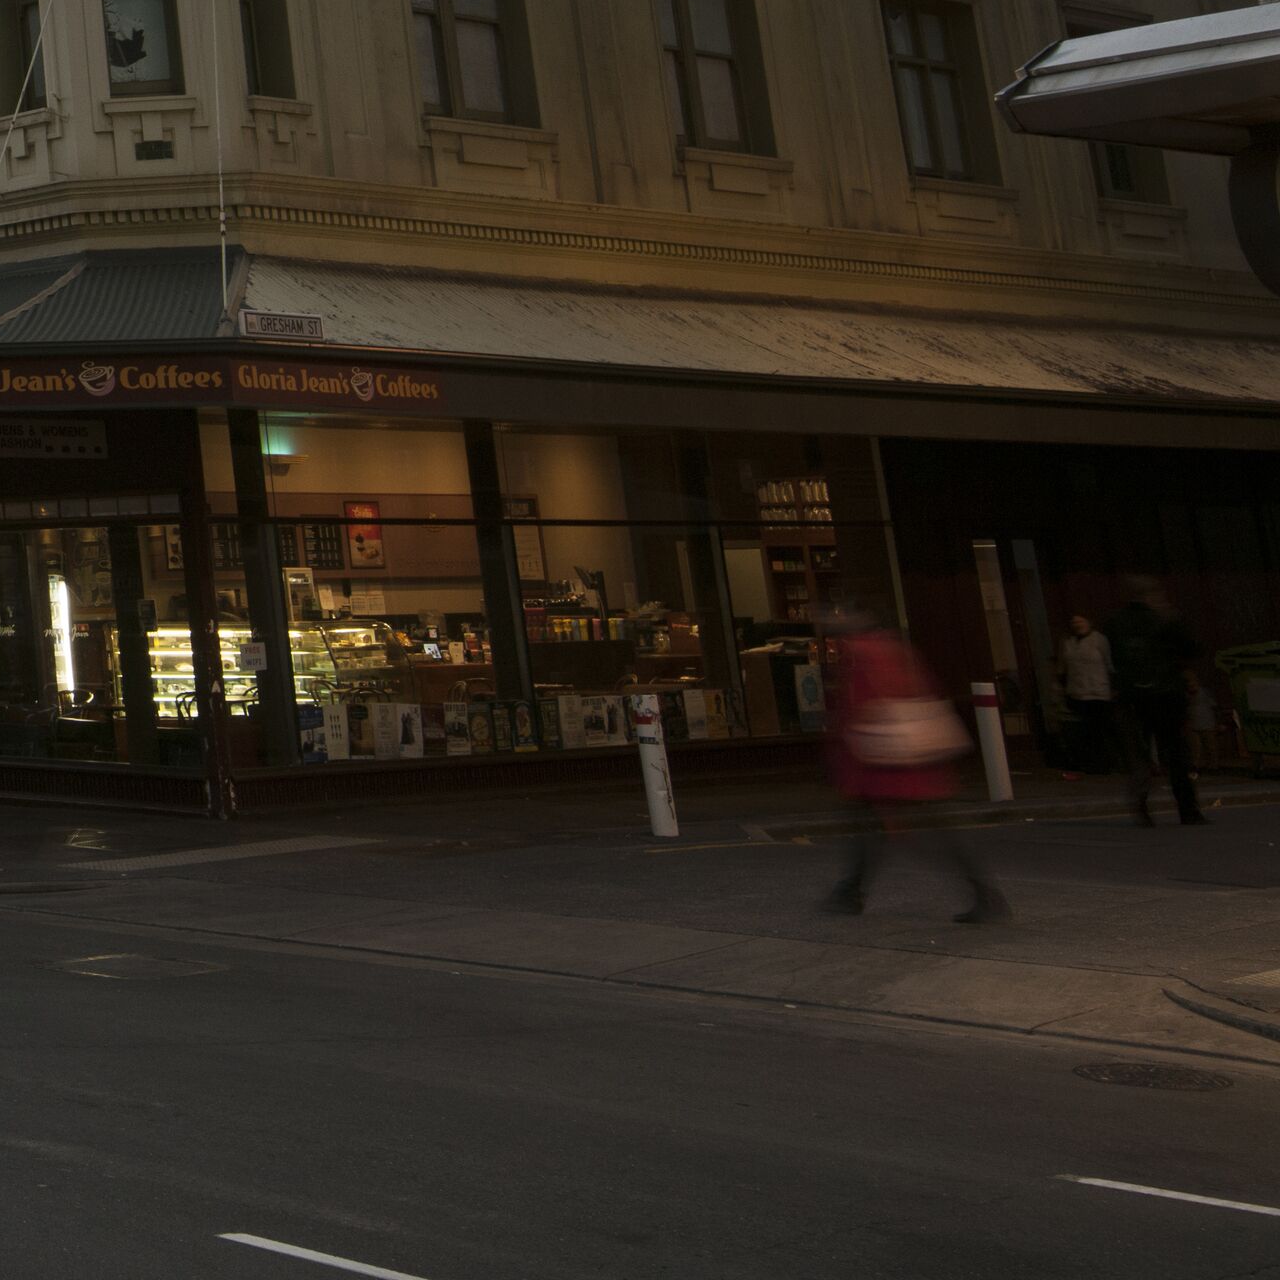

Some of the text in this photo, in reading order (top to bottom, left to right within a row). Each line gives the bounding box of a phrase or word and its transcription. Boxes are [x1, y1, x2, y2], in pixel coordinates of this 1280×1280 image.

[260, 316, 318, 335] GRESHAM ST
[0, 368, 75, 393] Jean's
[119, 365, 222, 390] Coffees
[239, 364, 438, 399] Gloria Jean's Coffees
